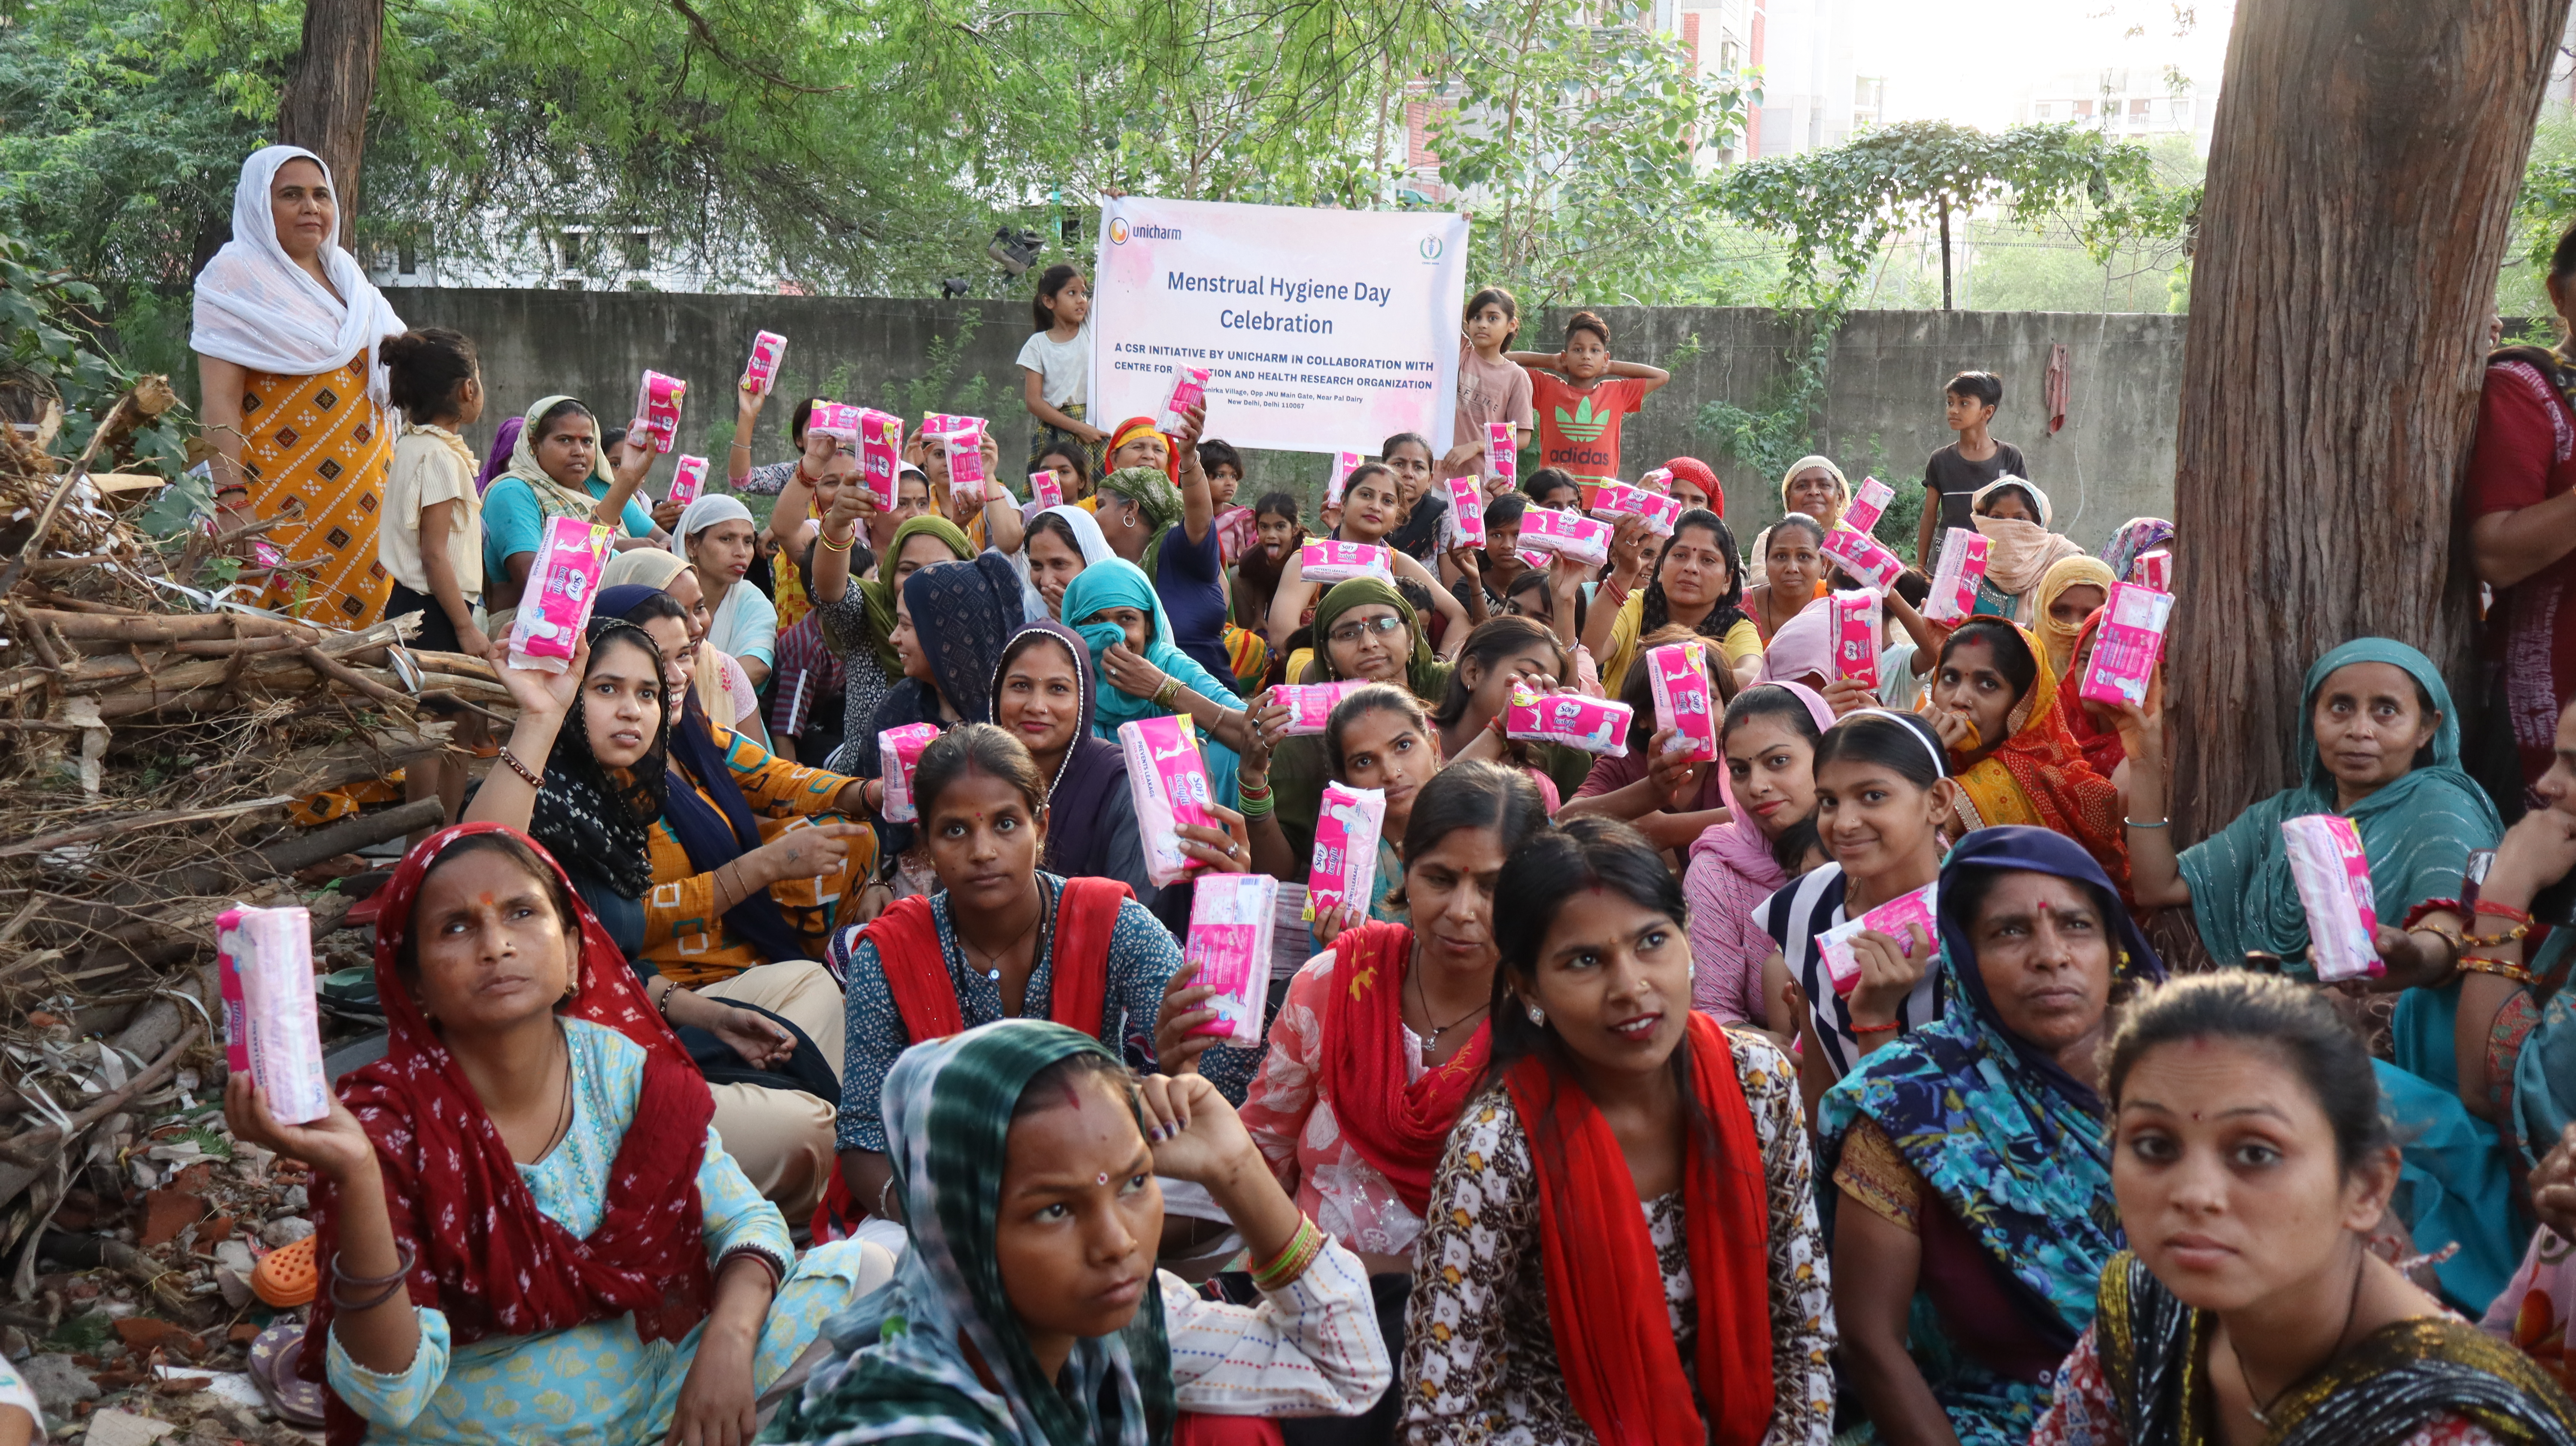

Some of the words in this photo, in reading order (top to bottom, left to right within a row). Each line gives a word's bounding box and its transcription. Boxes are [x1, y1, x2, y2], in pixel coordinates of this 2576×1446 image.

[1133, 224, 1182, 240] unicharm
[1168, 271, 1264, 295] Menstrual
[1270, 277, 1348, 303] Hygiene
[1355, 283, 1391, 307] Day
[1220, 310, 1333, 334] Celebration
[1115, 343, 1121, 351] A
[1125, 343, 1145, 353] CSR
[1149, 346, 1206, 358] INITIATIVE
[1209, 350, 1224, 359] BY
[1228, 351, 1288, 363] UNICHARM
[1291, 355, 1303, 364] IN
[1307, 355, 1401, 370] COLLABORATION
[1405, 361, 1434, 371] WITH
[1115, 362, 1151, 372] CENTRE
[1154, 365, 1173, 374] FOR
[1234, 371, 1255, 380] AND
[1258, 372, 1297, 382] HEALTH
[1300, 374, 1353, 385] RESEARCH
[1357, 378, 1432, 389] ORGANIZATION
[1225, 388, 1249, 396] Village,
[1297, 393, 1315, 401] Gate,
[1458, 385, 1498, 412] EFINE
[1549, 447, 1609, 466] adidas
[1626, 501, 1643, 510] bodyfit
[1557, 524, 1576, 532] bodyfit
[541, 529, 553, 554] PREVENTS
[532, 554, 543, 577] LEAKAGE
[554, 567, 569, 594] bodyfit
[569, 575, 583, 595] SOFY
[1560, 705, 1575, 715] SOFY
[1679, 692, 1689, 714] bodyfit
[1554, 718, 1576, 728] bodyfit
[1138, 741, 1148, 770] PREVENTS
[1145, 771, 1155, 798] LEAKAGE
[1175, 775, 1190, 805] bodyfit
[1194, 777, 1205, 798] SOFY
[1315, 848, 1324, 867] SOFY
[1327, 847, 1338, 875] bodyfit
[1347, 887, 1355, 911] PREVENTS
